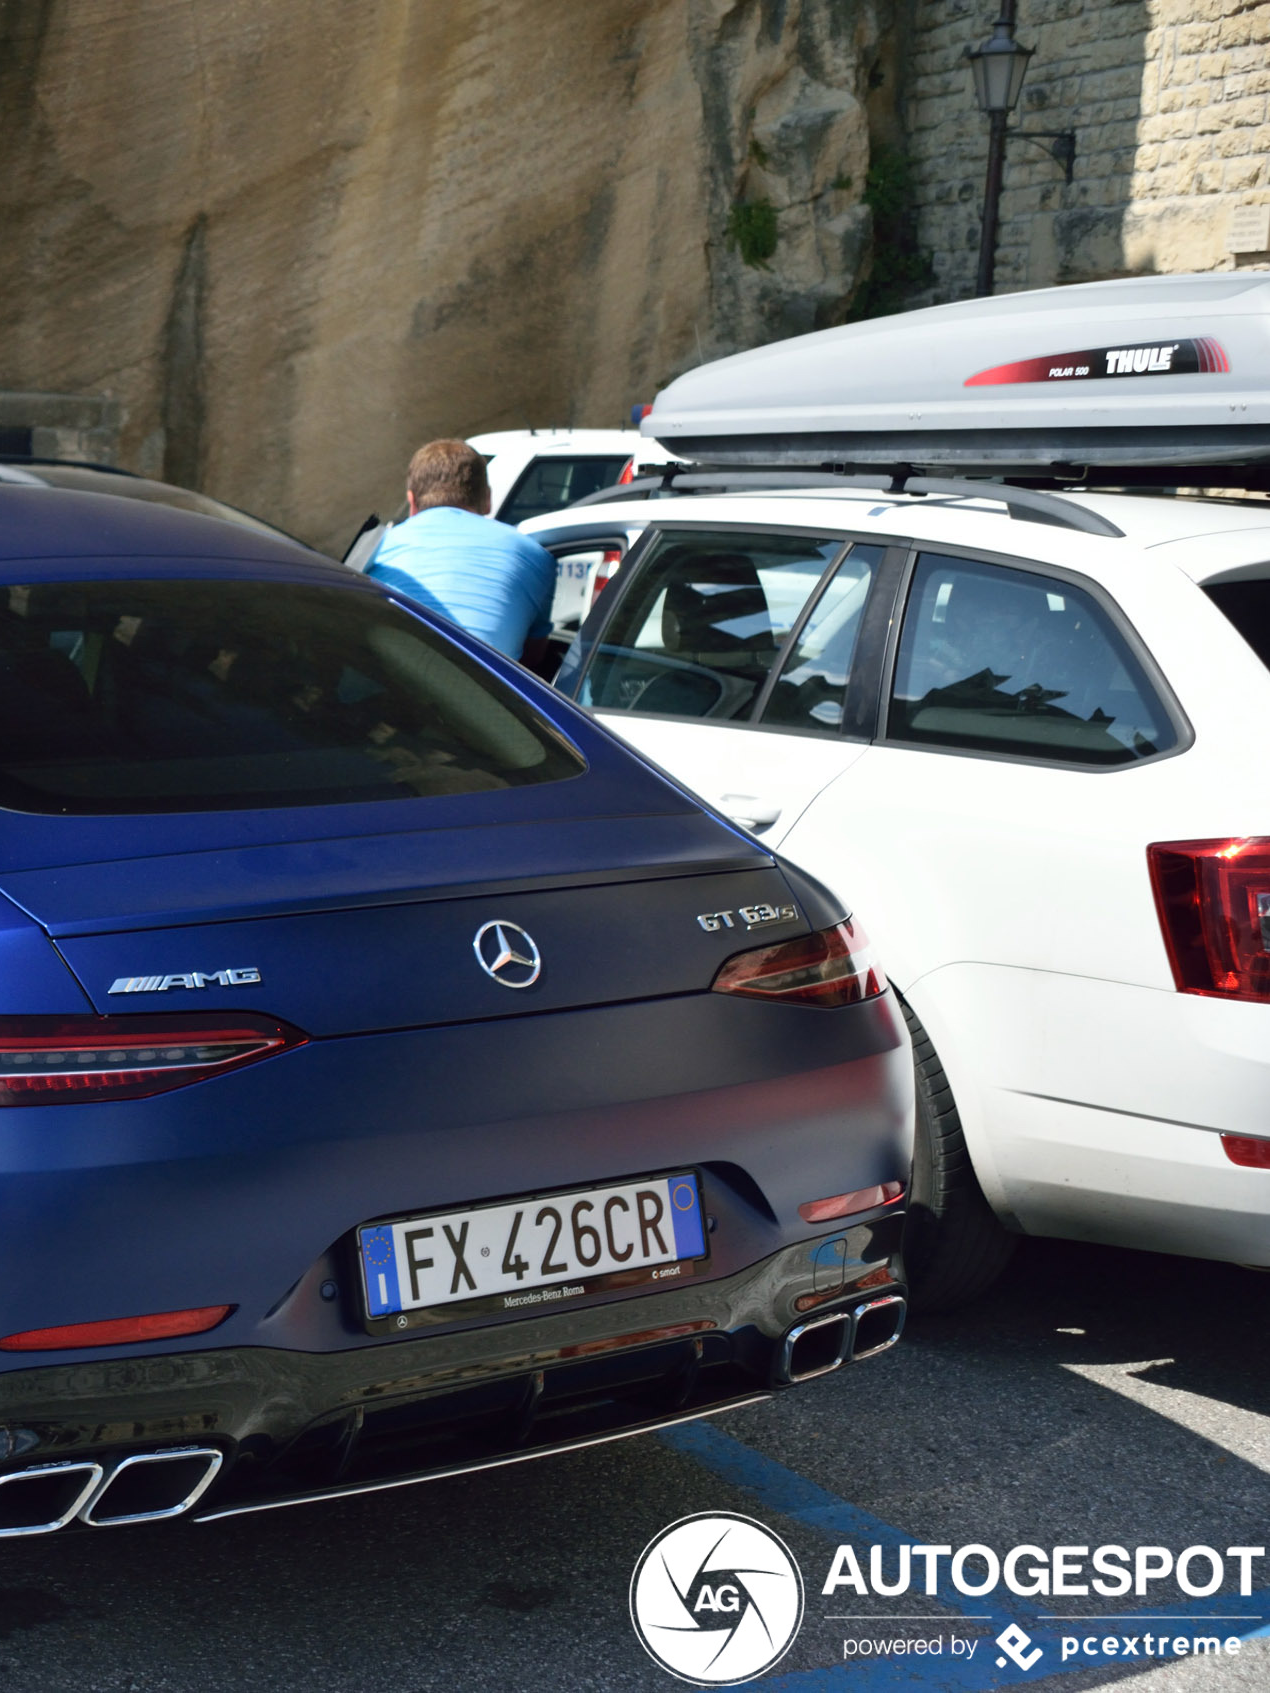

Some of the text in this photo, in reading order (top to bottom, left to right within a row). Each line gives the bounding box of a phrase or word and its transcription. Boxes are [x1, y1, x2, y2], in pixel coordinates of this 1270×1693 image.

[1048, 366, 1090, 378] POLAR 500
[1105, 346, 1174, 375] THULE
[696, 910, 735, 932] GT
[403, 1221, 478, 1302] FX
[501, 1190, 669, 1281] 426CR
[659, 1266, 681, 1279] smart
[504, 1285, 586, 1309] Mercedes-Benz Roma
